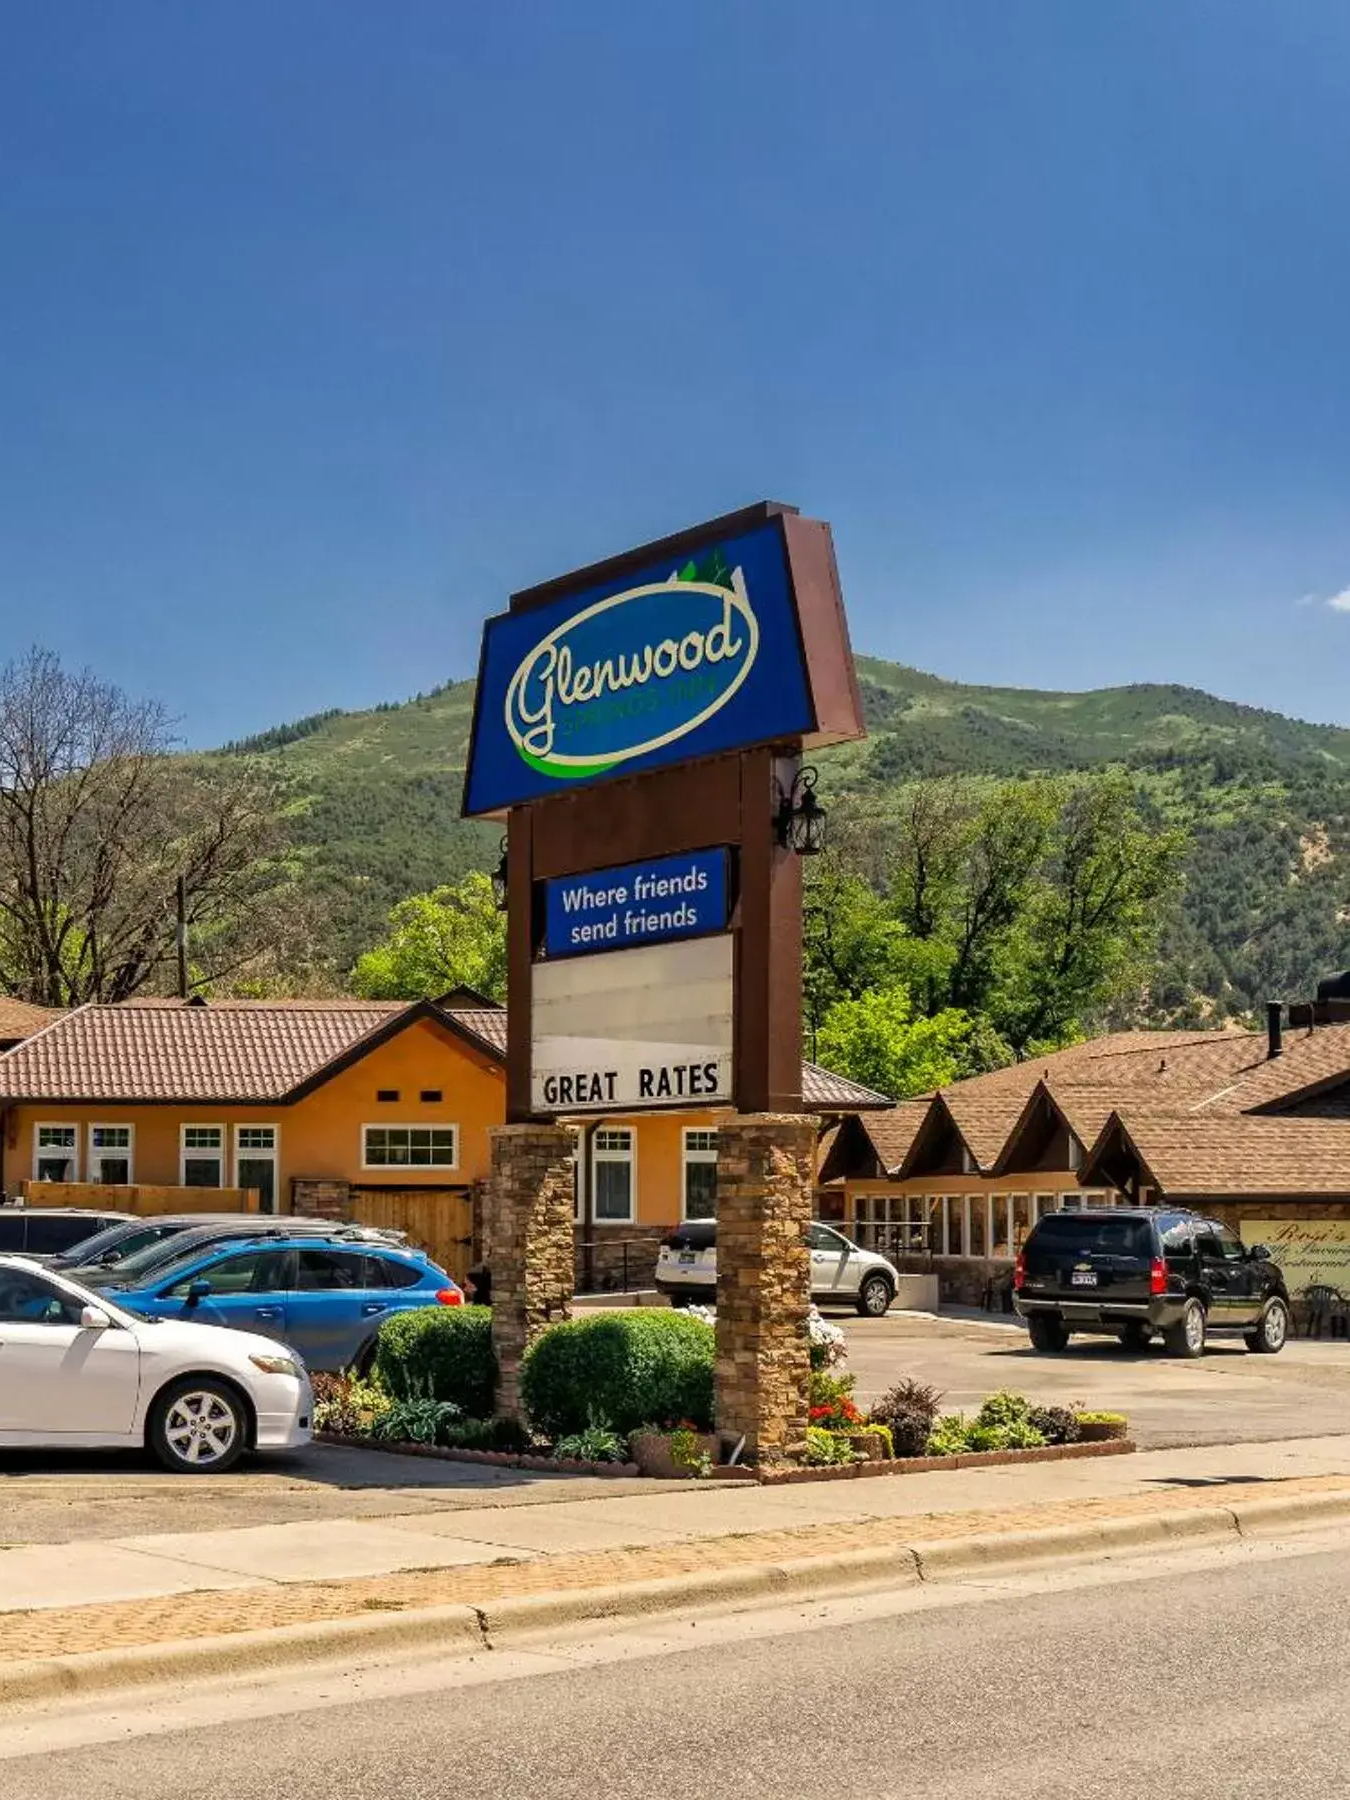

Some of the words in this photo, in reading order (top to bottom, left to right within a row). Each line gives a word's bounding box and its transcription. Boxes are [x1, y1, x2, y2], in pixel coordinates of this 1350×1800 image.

[518, 589, 742, 757] Glenwood
[562, 887, 628, 913] Where
[634, 865, 708, 901] friends
[571, 913, 618, 944] send
[624, 902, 698, 936] friends
[543, 1071, 618, 1105] GREAT
[639, 1062, 719, 1098] RATES
